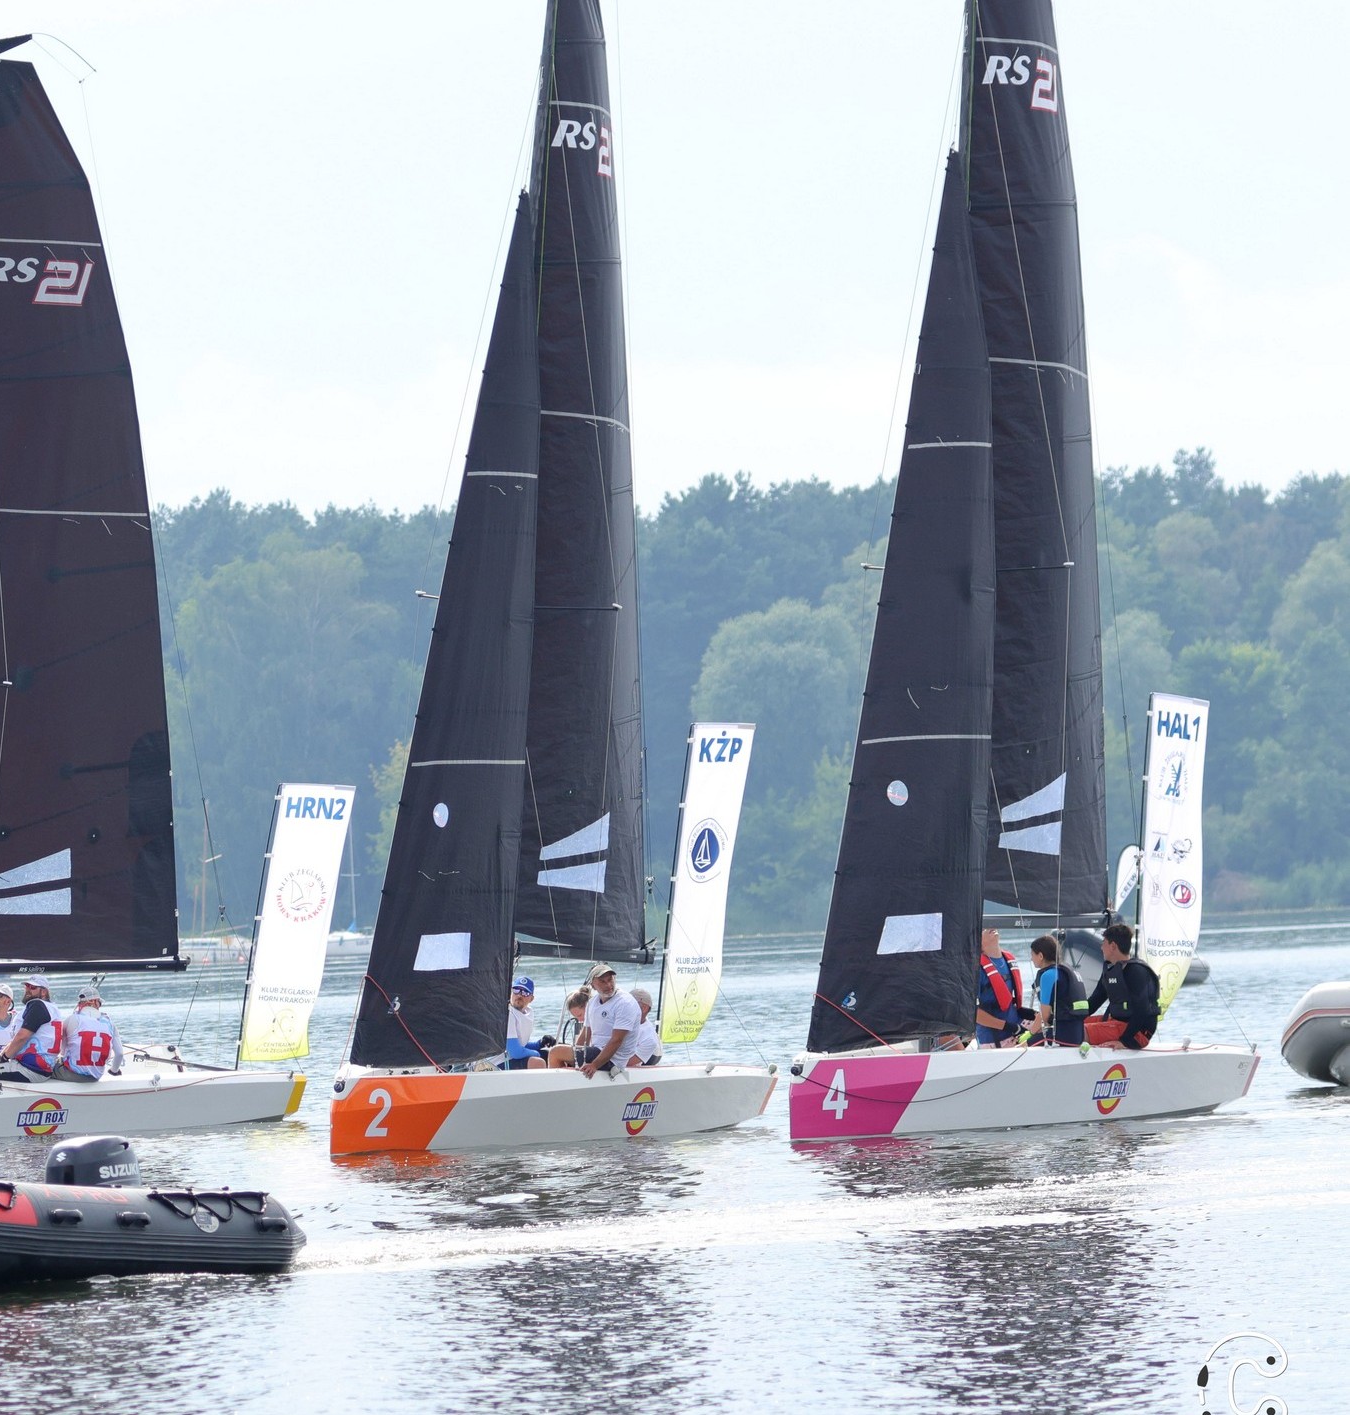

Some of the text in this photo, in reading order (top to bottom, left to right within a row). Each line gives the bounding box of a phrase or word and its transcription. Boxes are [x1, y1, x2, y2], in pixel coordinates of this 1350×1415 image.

[699, 730, 743, 763] KŻP
[285, 796, 347, 820] HRN2
[1120, 872, 1138, 899] CREW
[1157, 938, 1195, 948] ŻEGLARSK
[76, 1031, 113, 1067] H
[822, 1068, 849, 1120] 4
[1094, 1081, 1129, 1098] BUD ROX
[19, 1111, 65, 1126] BUD ROX
[364, 1088, 392, 1137] 2
